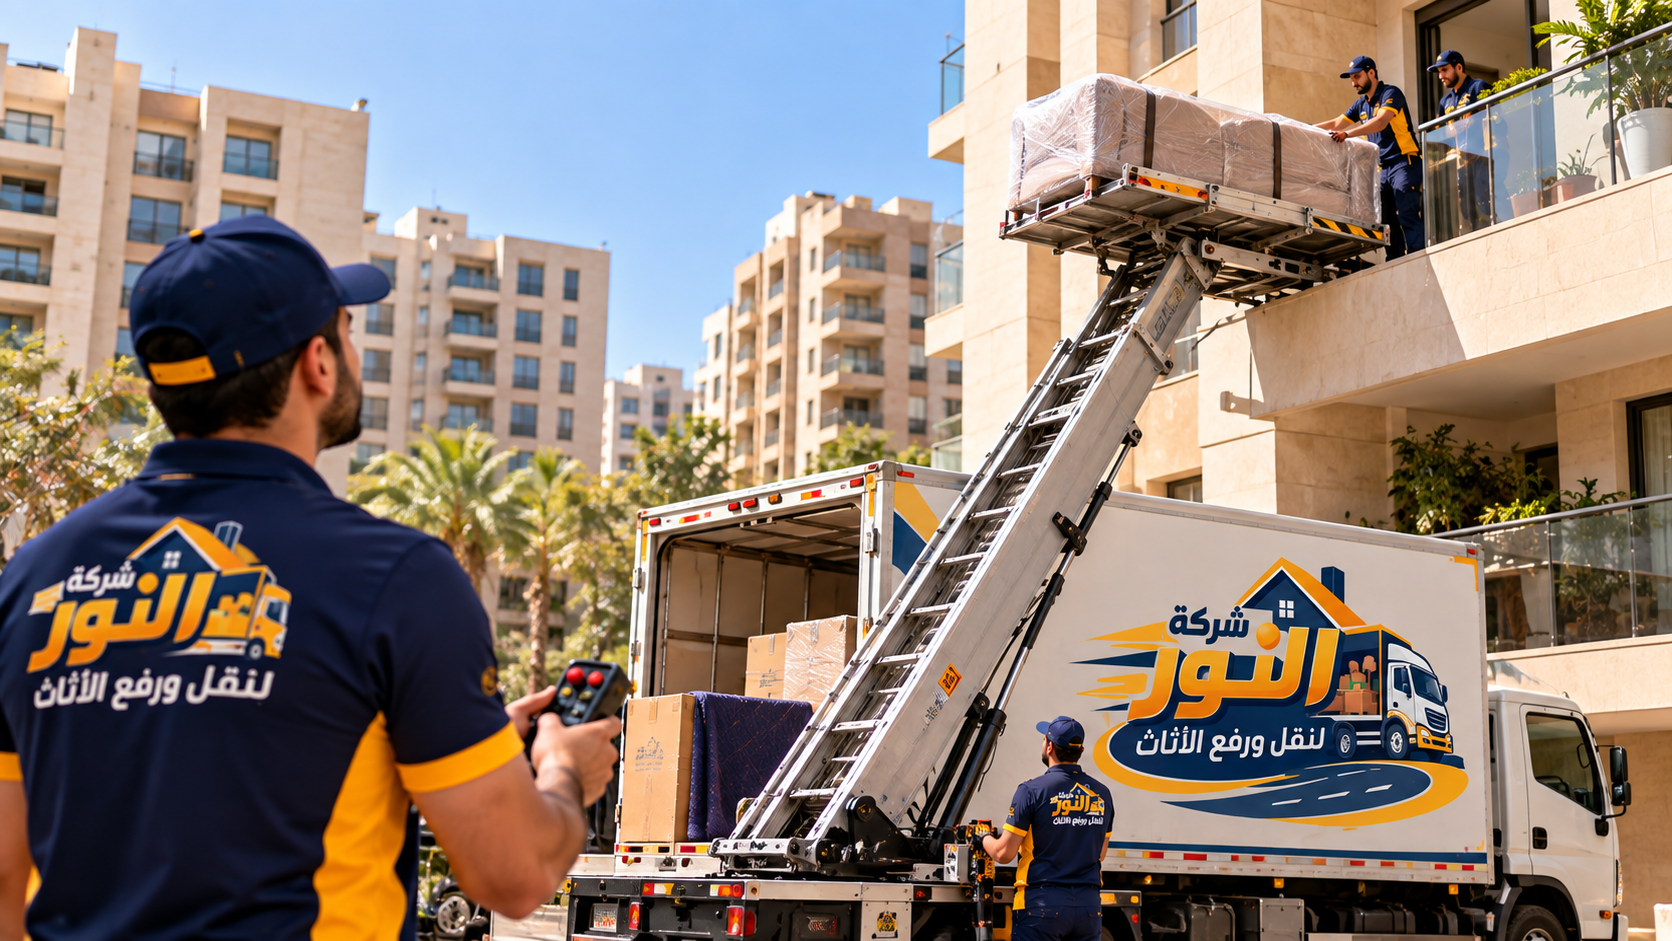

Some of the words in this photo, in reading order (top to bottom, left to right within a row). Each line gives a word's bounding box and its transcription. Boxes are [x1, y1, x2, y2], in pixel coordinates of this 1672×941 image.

[66, 560, 137, 597] شركة
[27, 572, 217, 673] النور
[1168, 604, 1250, 645] شركة
[33, 669, 109, 709] الأثاث
[111, 668, 182, 710] ورفع
[186, 665, 275, 704] لنقل
[1126, 622, 1341, 722] النور
[1135, 725, 1204, 757] الأثاث
[1209, 728, 1265, 762] ورفع
[1269, 726, 1325, 757] لنقل
[1051, 794, 1090, 816] النور
